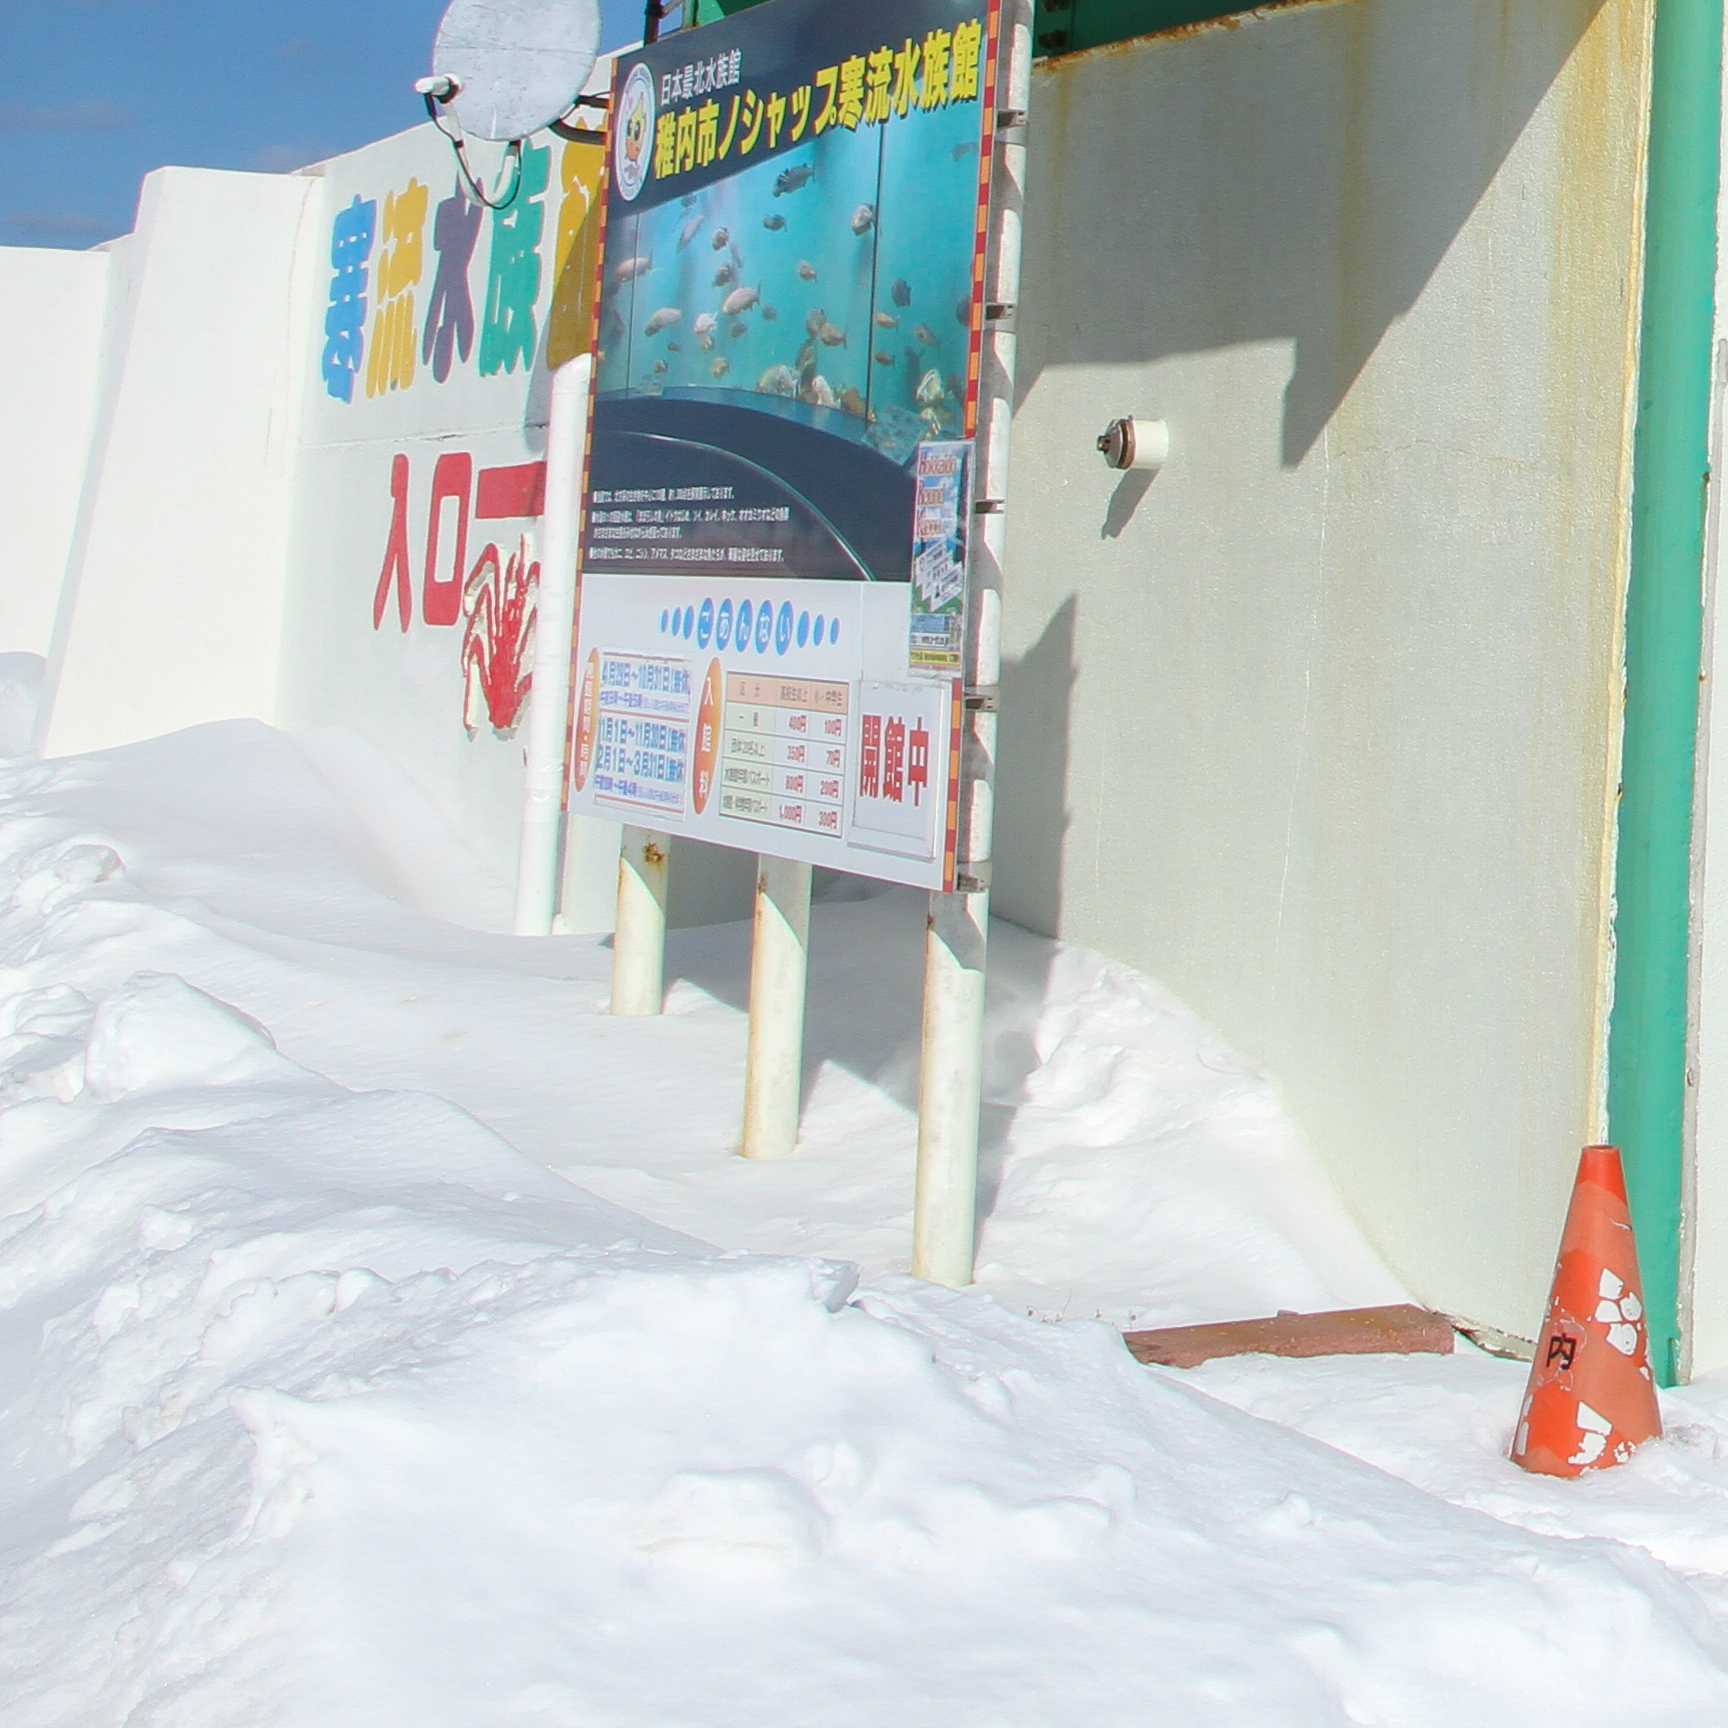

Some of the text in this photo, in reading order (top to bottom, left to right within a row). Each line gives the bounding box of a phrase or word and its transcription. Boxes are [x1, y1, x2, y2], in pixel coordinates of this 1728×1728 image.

[655, 18, 984, 179] 稚内市ノシャップ寒流水族館
[660, 48, 742, 105] 日本最北水族館
[858, 714, 930, 807] 開館中
